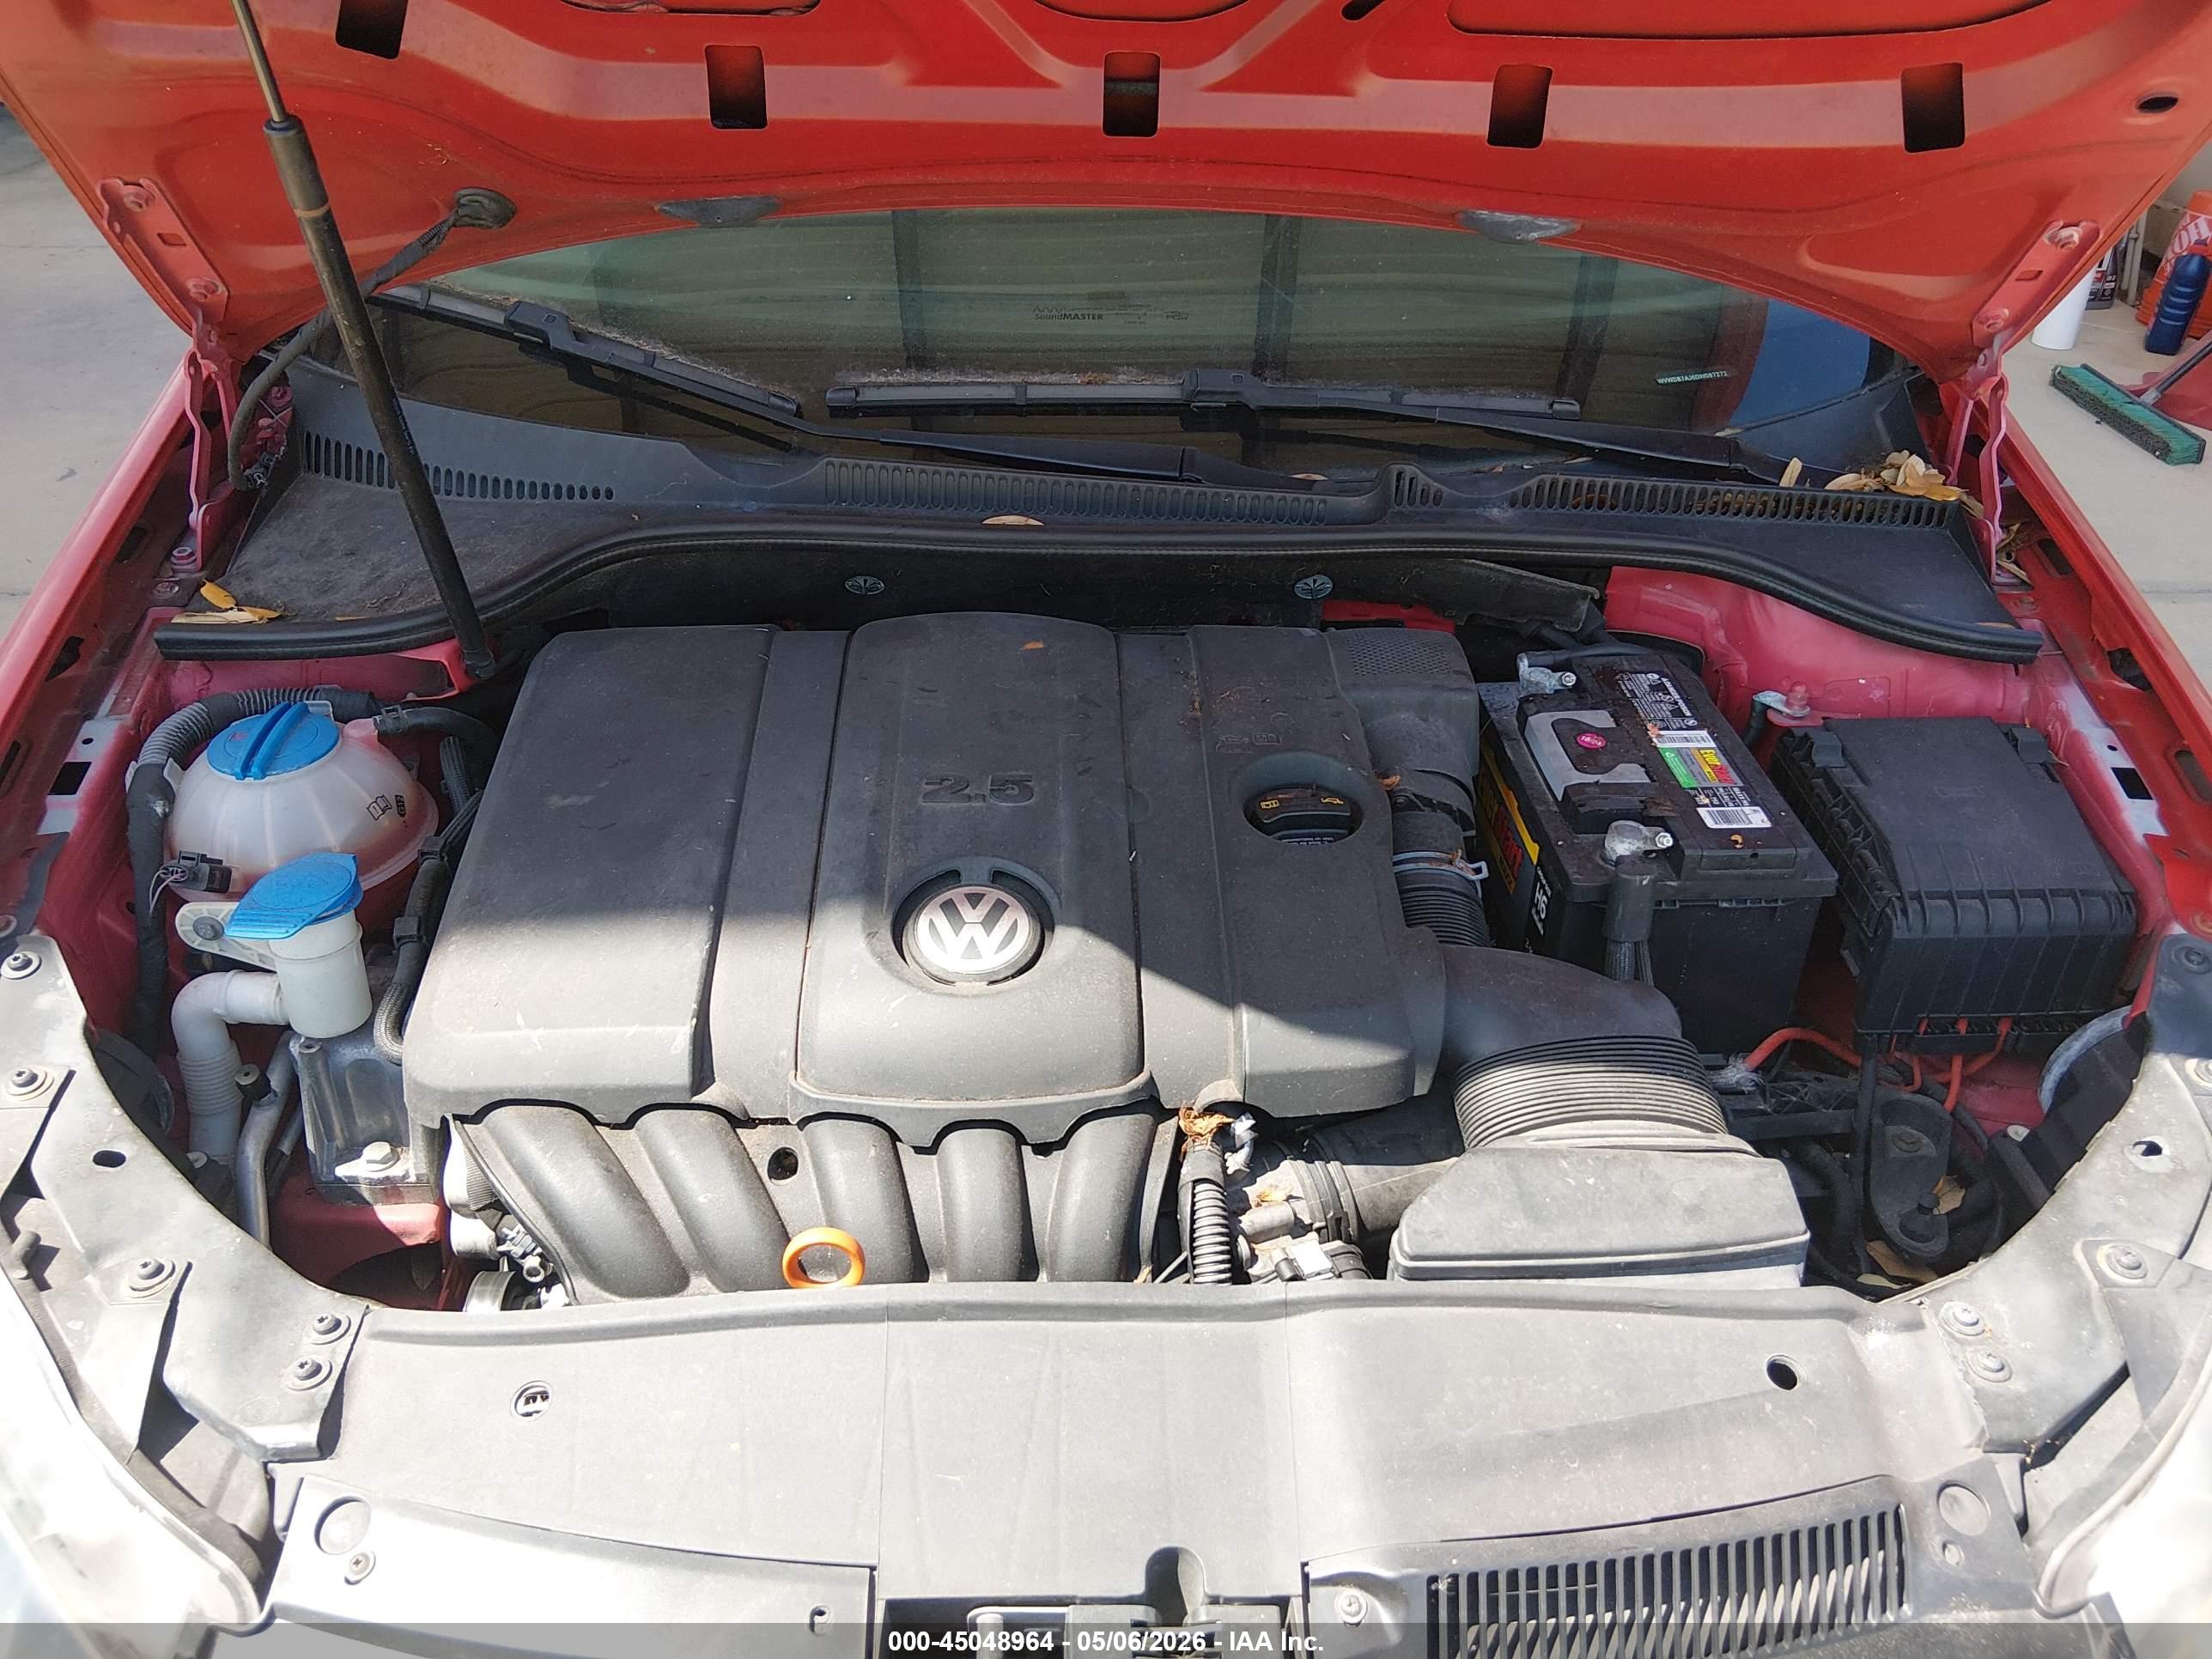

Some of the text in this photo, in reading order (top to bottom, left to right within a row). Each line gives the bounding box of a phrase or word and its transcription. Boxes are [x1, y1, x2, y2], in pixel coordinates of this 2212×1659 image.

[1034, 312, 1104, 321] SoundMASTER
[921, 773, 1035, 805] 2.5
[1534, 881, 1548, 920] H6
